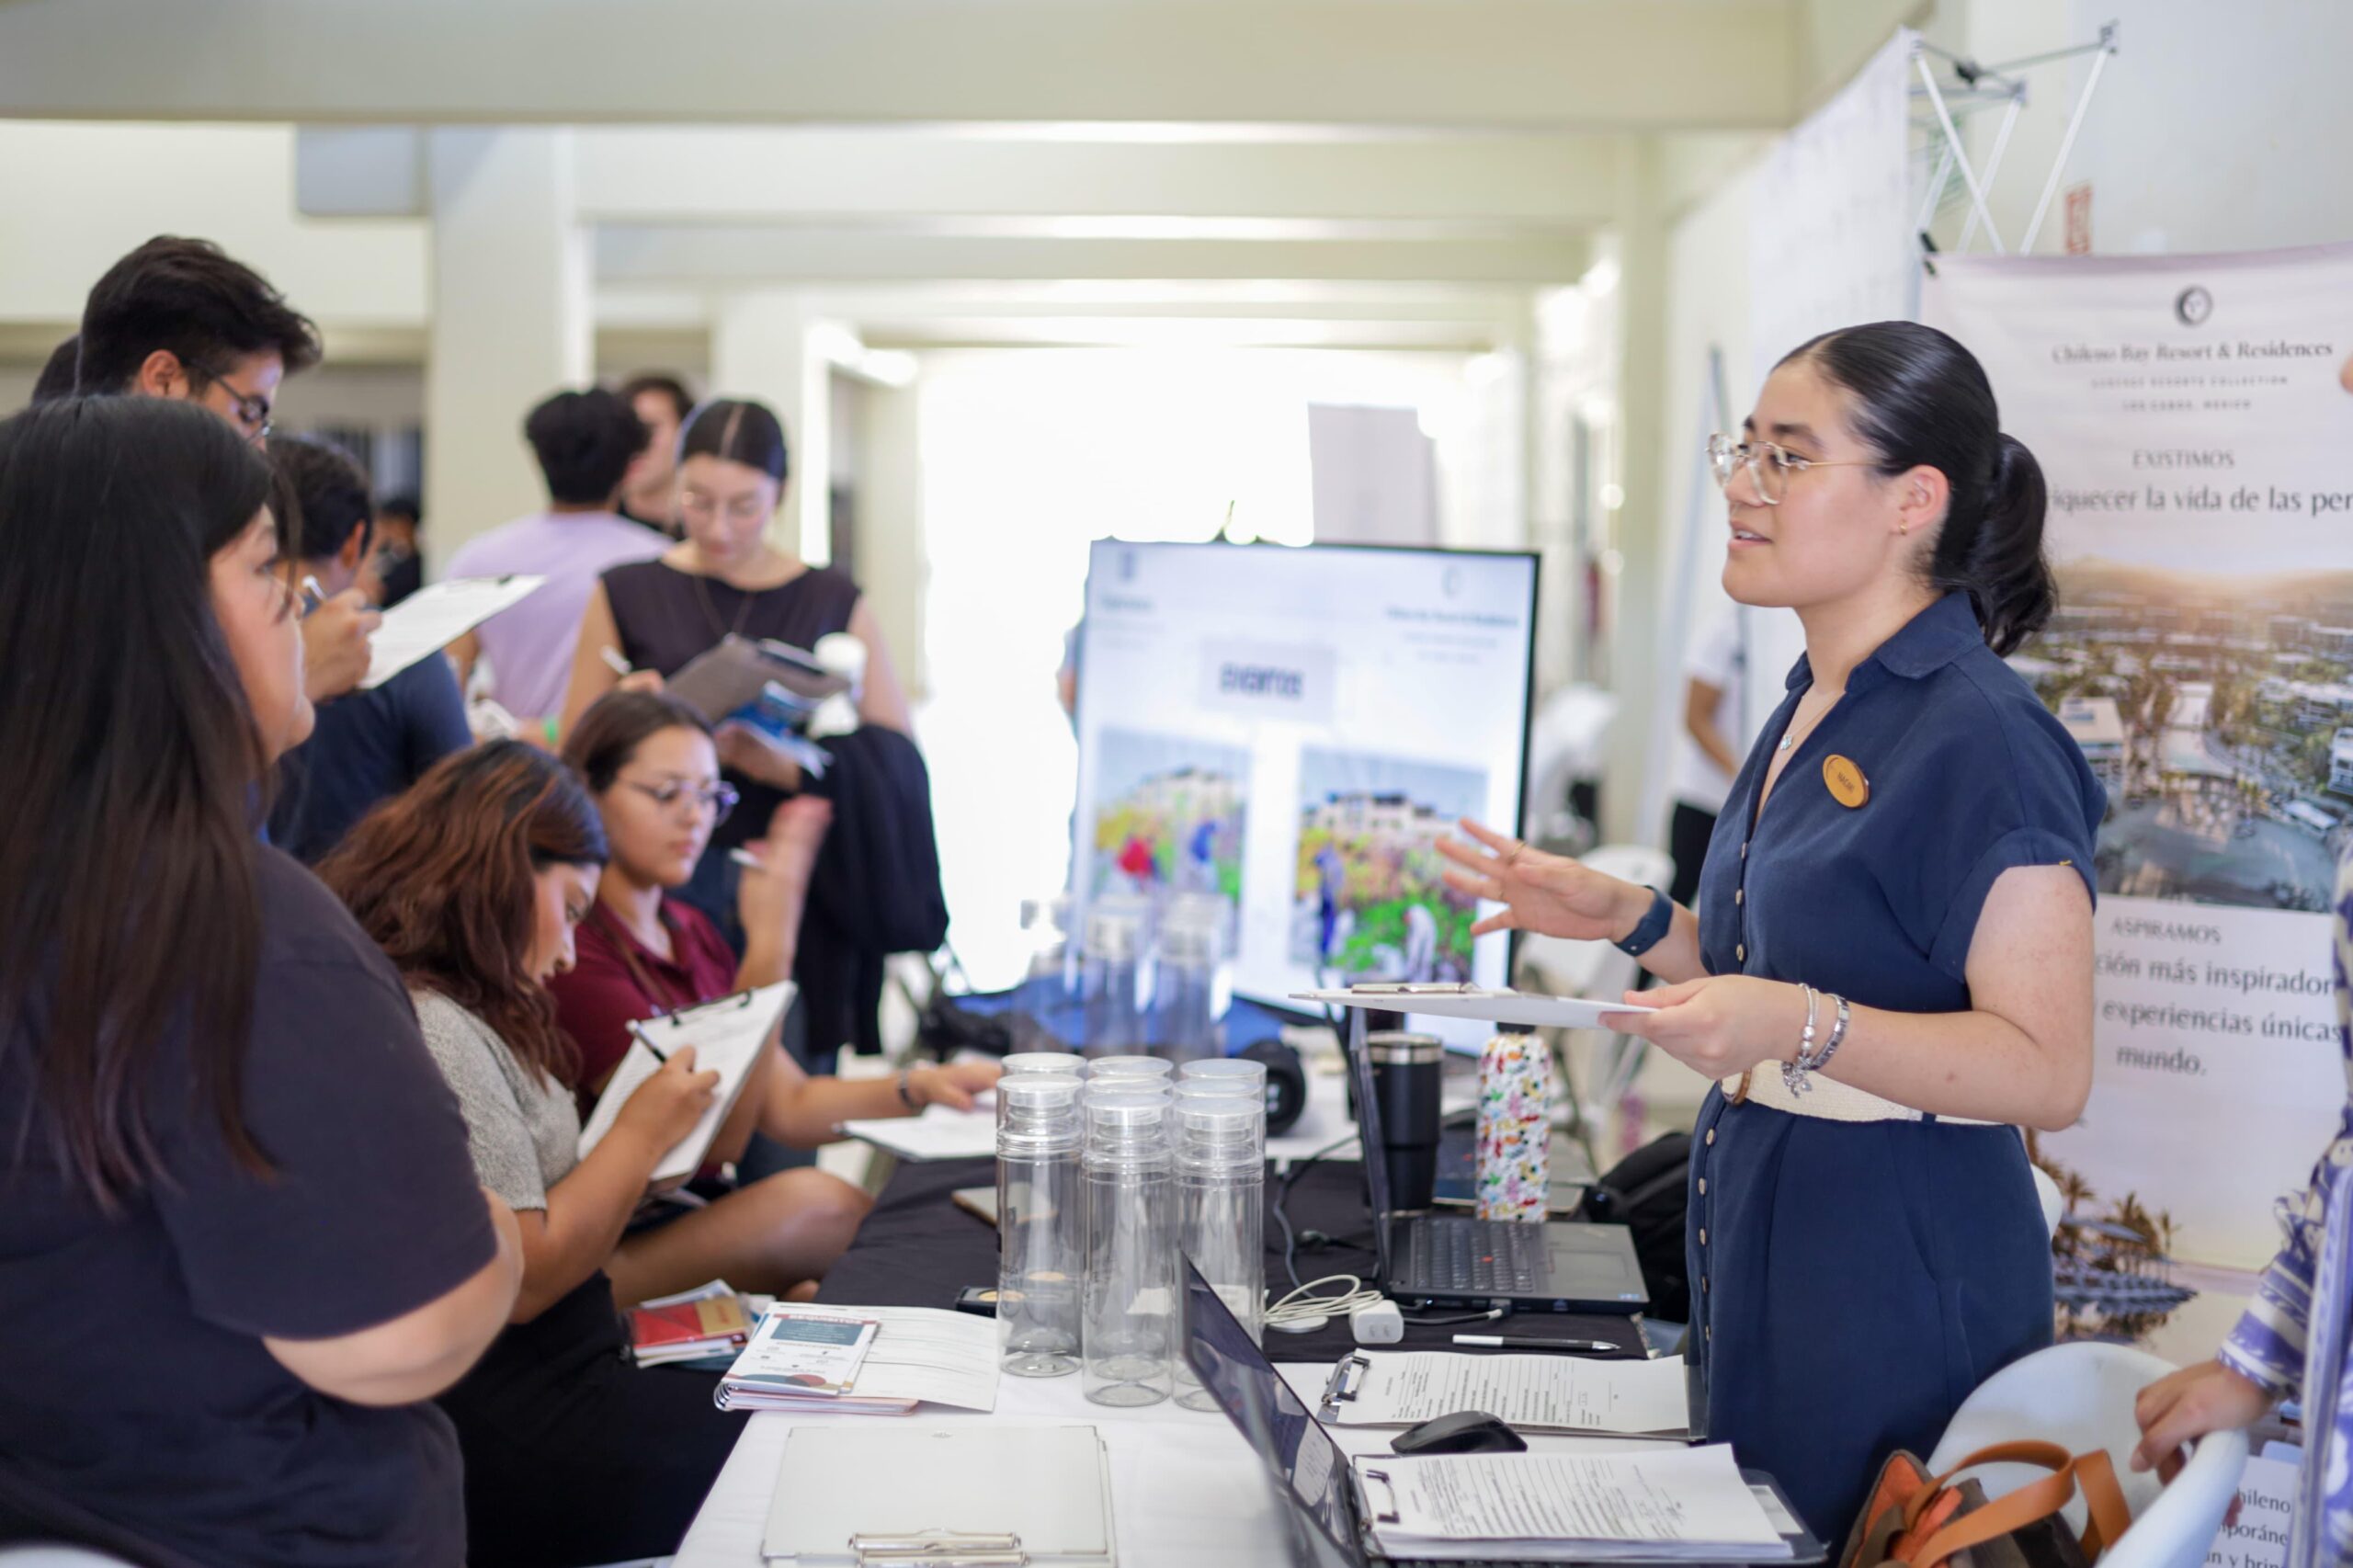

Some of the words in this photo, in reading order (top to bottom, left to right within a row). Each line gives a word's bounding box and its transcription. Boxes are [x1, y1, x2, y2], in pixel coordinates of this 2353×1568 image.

[2052, 342, 2116, 365] Chileno
[2120, 343, 2150, 367] Bay
[2156, 340, 2212, 361] Resort
[2217, 341, 2231, 360] &
[2238, 339, 2333, 359] Residences
[2132, 449, 2235, 470] EXISTIMOS
[2049, 483, 2137, 517] iquecer
[2146, 483, 2166, 511] la
[2174, 483, 2222, 512] vida
[2230, 484, 2260, 512] de
[2268, 484, 2302, 513] las
[2112, 917, 2222, 946] ASPIRAMOS
[2148, 956, 2198, 985] más
[2102, 999, 2253, 1037] experiencias
[2261, 1010, 2342, 1043] únicas
[2116, 1045, 2207, 1076] mundo.
